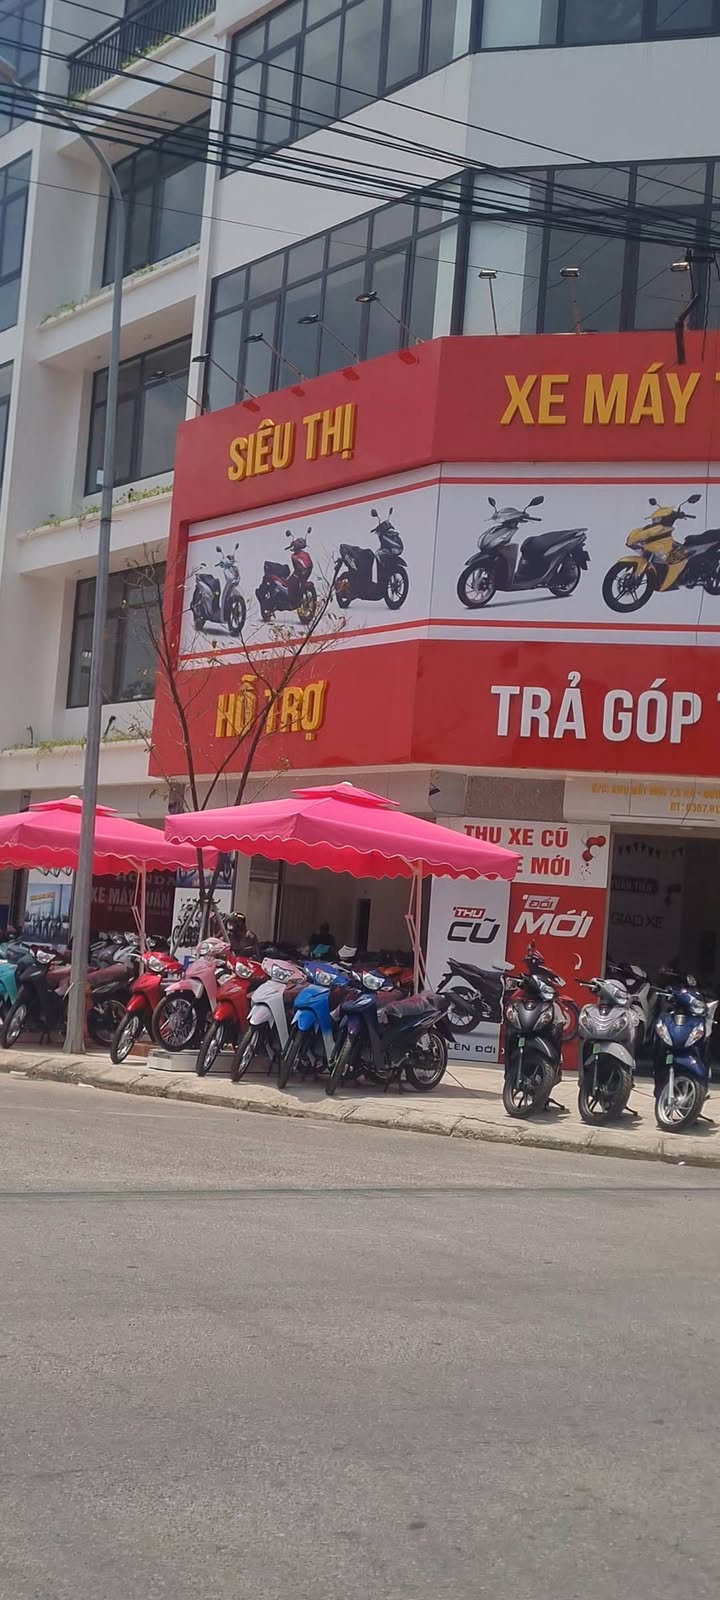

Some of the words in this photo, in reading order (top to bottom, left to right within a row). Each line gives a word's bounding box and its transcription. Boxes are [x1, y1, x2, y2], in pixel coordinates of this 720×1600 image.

[500, 373, 570, 426] XE
[583, 362, 701, 426] MÁY
[227, 418, 294, 481] SIÊU
[302, 402, 356, 460] THỊ
[215, 674, 258, 738] HỖ
[263, 680, 328, 742] TRỢ
[490, 671, 587, 741] TRẢ
[602, 678, 703, 744] GÓP
[464, 824, 502, 844] THU
[508, 827, 534, 846] XE
[541, 826, 569, 848] CŨ
[531, 854, 570, 877] MỚI
[456, 908, 483, 918] THU
[513, 908, 594, 938] MỚI
[447, 917, 500, 944] CŨ
